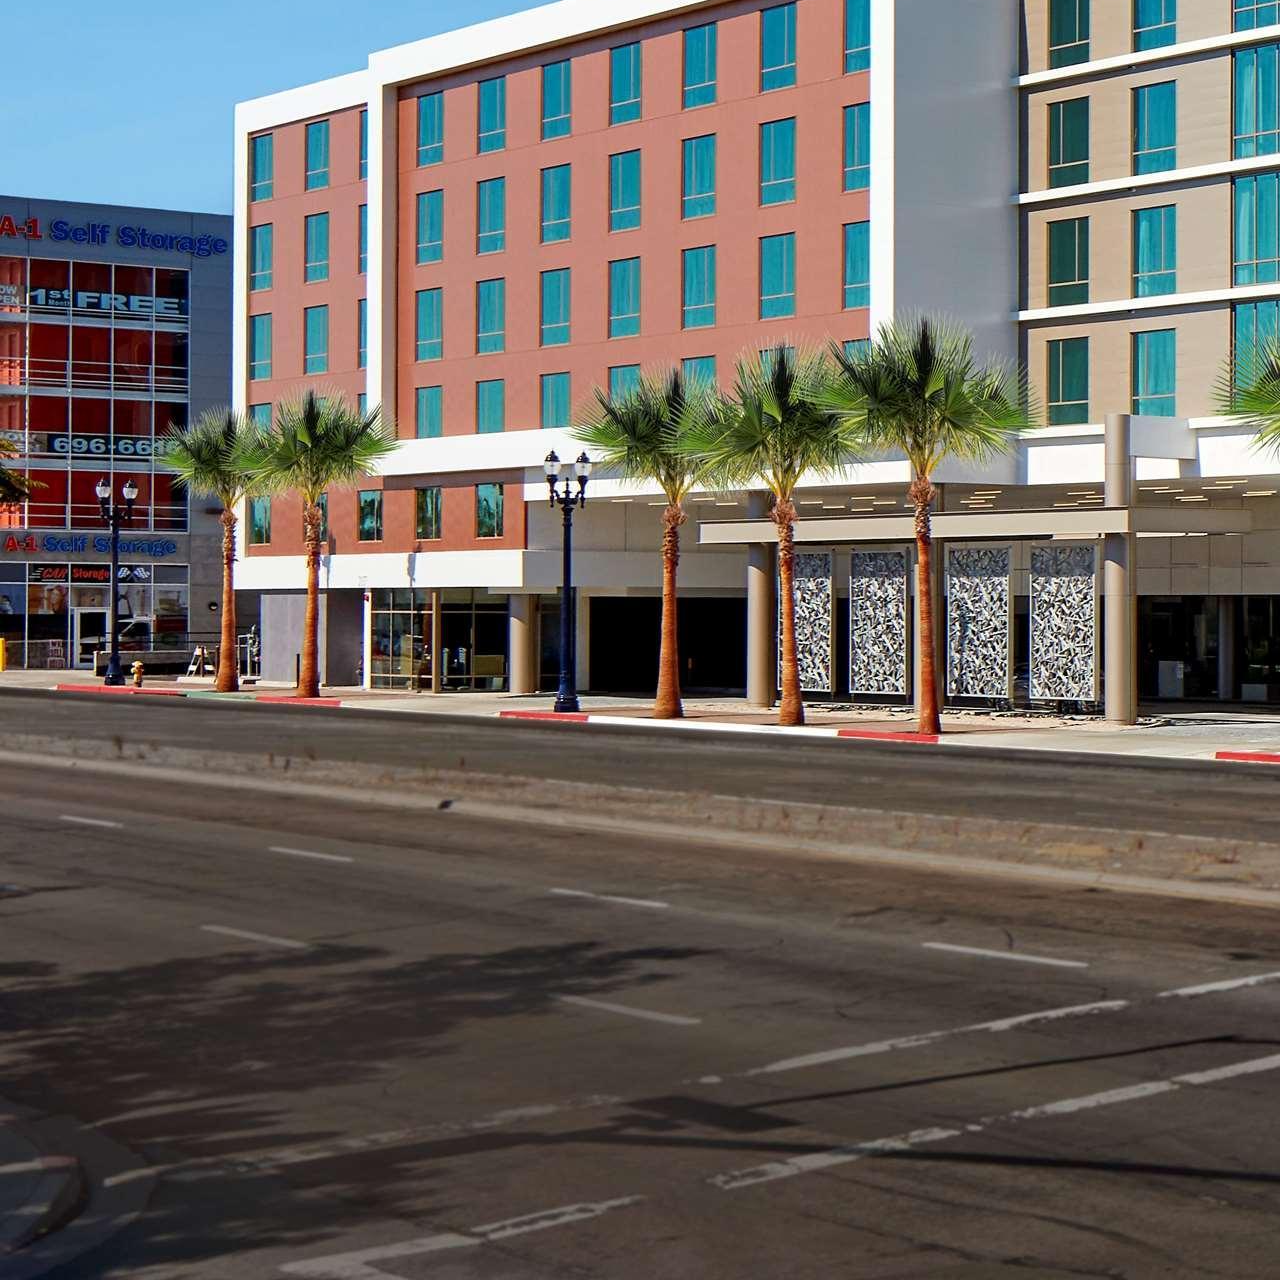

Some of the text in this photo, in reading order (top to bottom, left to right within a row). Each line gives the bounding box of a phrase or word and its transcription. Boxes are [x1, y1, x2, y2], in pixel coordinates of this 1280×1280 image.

[0, 215, 229, 257] A-1 Self Storage
[5, 535, 39, 552] A-1
[43, 535, 88, 553] Self
[42, 567, 109, 580] CAR Storage
